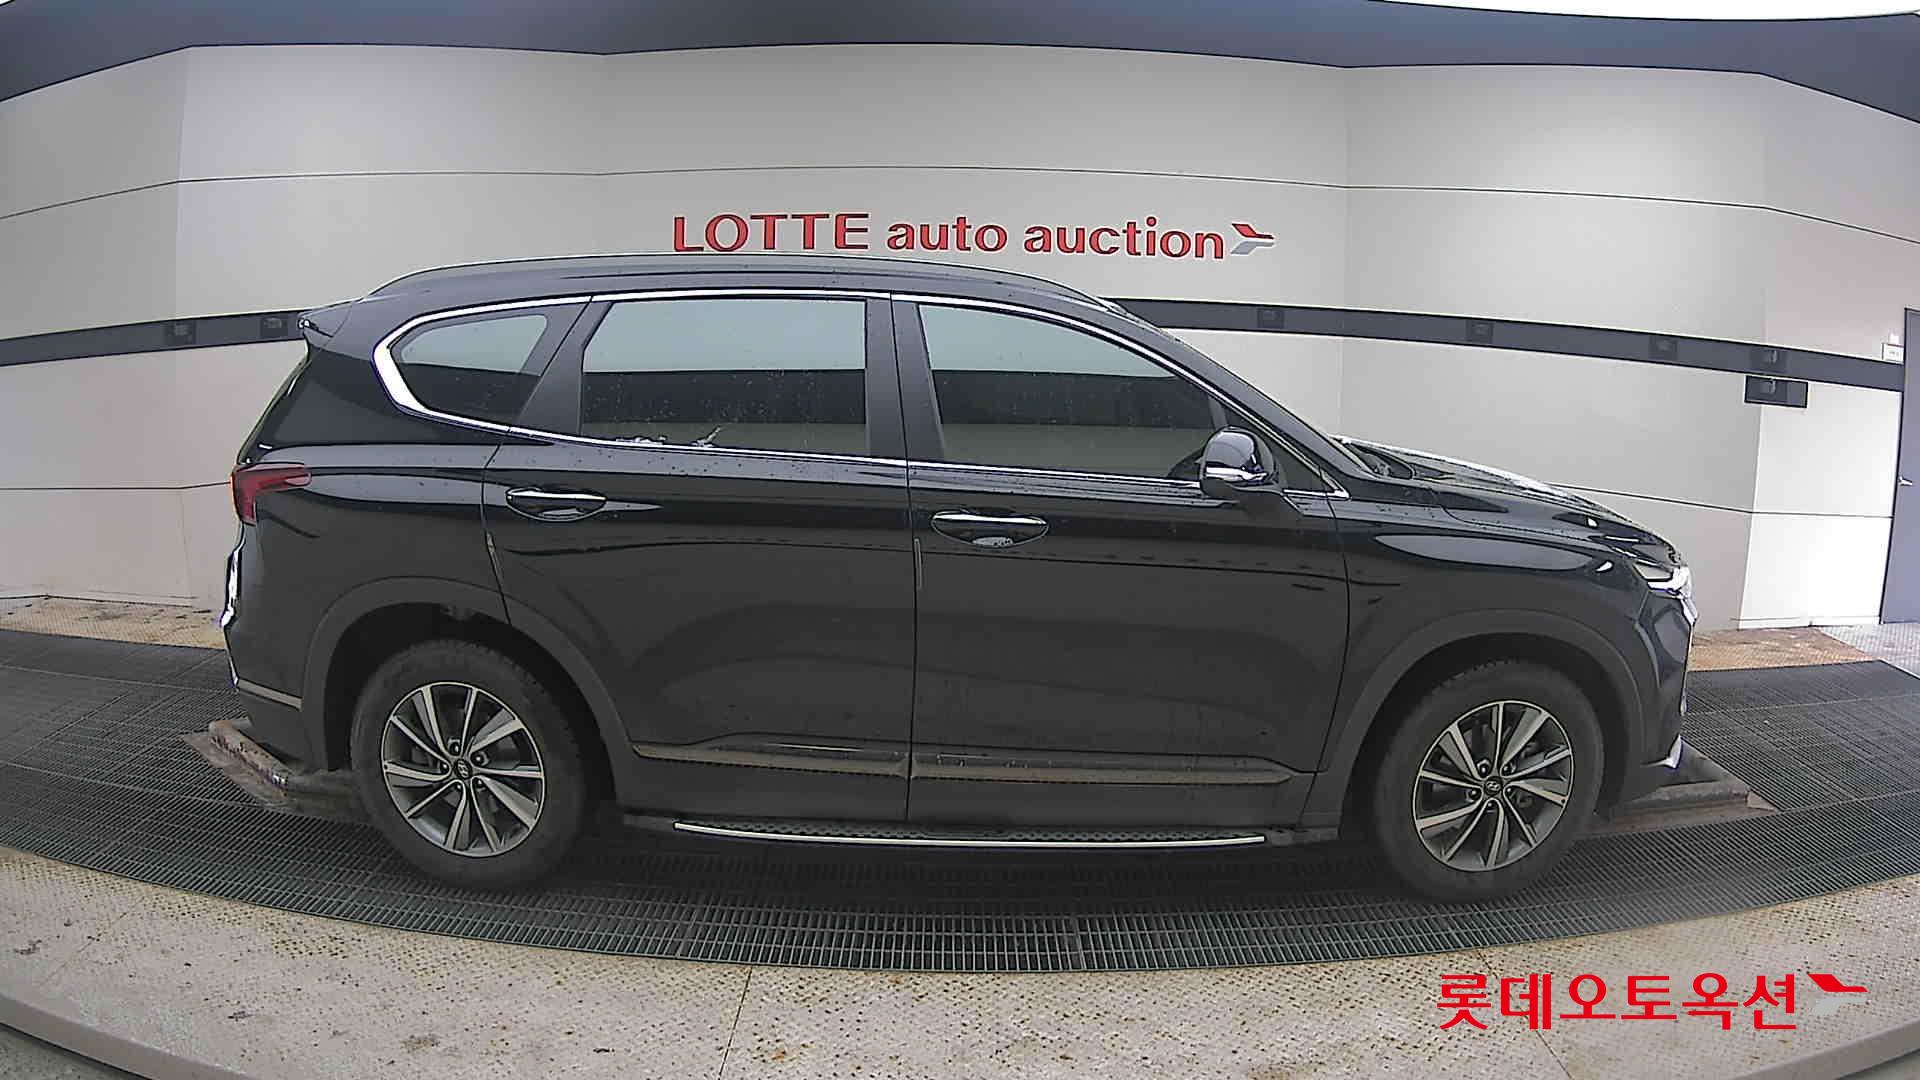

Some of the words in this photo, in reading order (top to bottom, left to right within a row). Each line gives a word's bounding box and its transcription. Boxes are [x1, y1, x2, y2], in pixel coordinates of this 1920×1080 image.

[673, 213, 870, 252] LOTTE
[887, 216, 1008, 252] auto
[1024, 217, 1225, 259] auction
